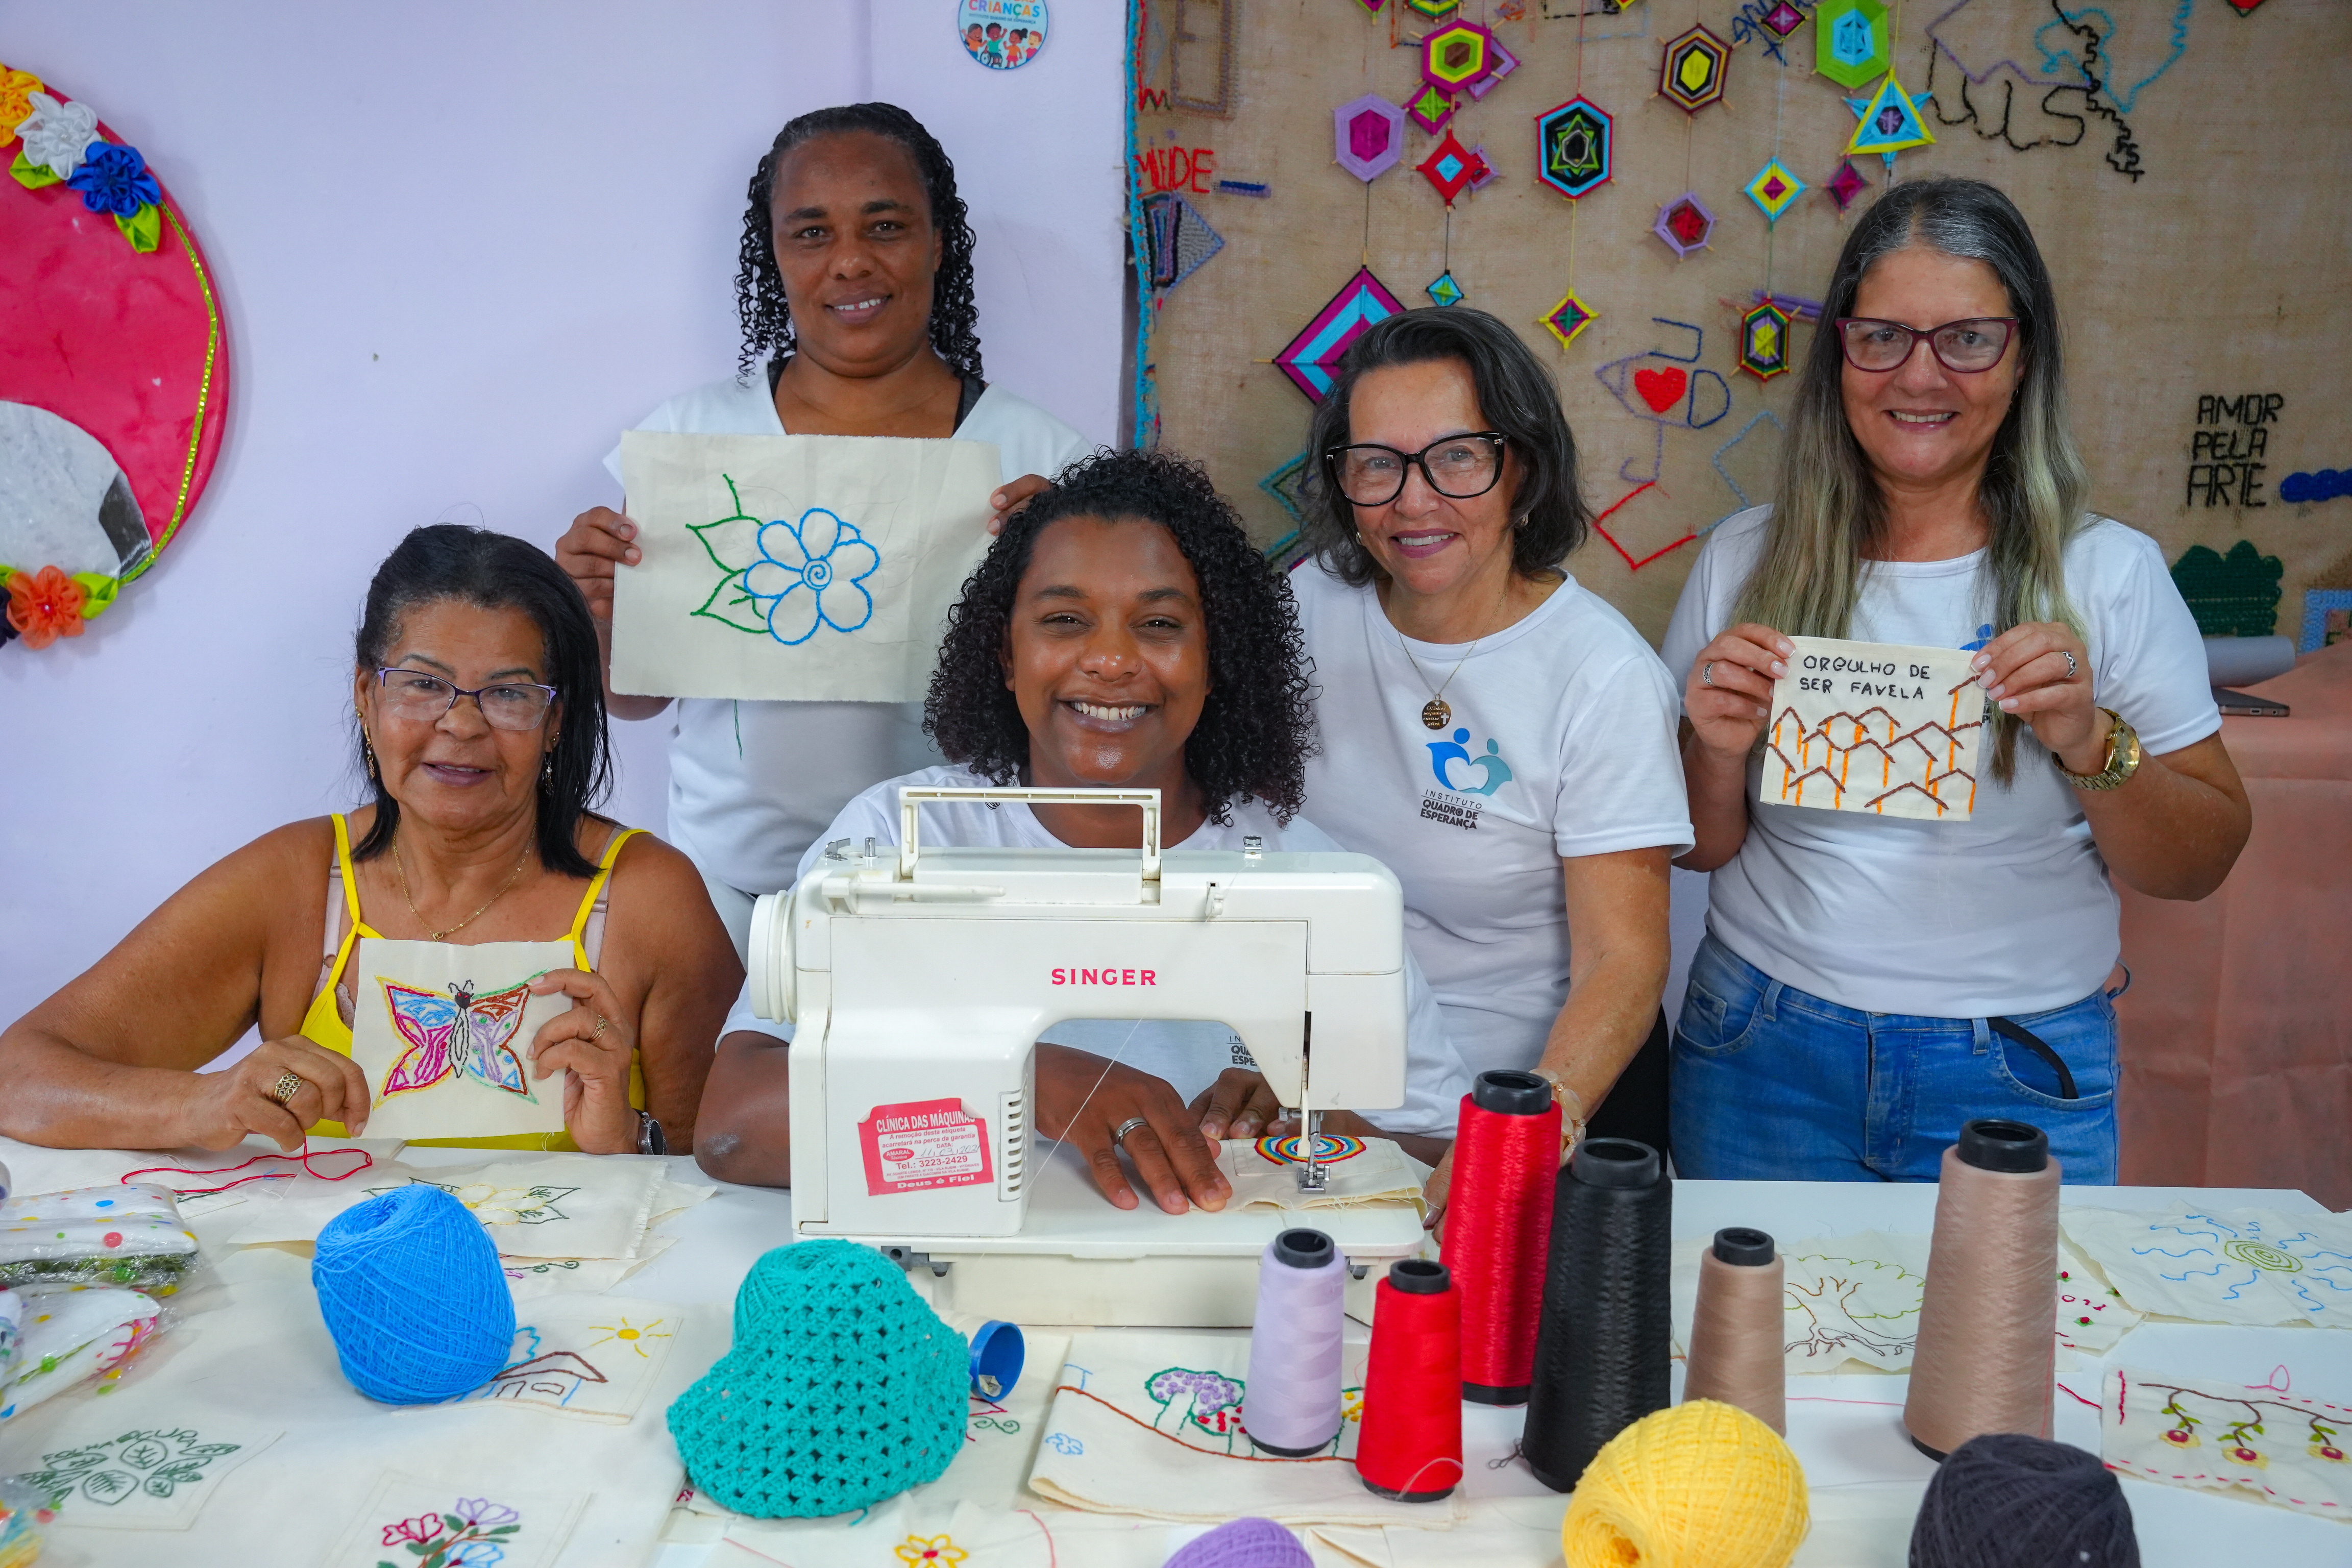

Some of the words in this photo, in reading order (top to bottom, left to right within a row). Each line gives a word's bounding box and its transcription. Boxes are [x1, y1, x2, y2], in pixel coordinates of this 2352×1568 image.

[969, 0, 1040, 19] CRIANÇAS
[2197, 394, 2284, 425] AMOR
[2193, 428, 2267, 460] PELA
[2187, 463, 2267, 507] ARTE
[1804, 655, 1895, 675] ORGULHO
[1910, 665, 1930, 679] DE
[1800, 677, 1832, 693] SER
[1851, 682, 1923, 699] FAVELA
[1426, 789, 1482, 809] INSTITUTO
[1420, 808, 1477, 830] ESPERANÇA
[1423, 799, 1463, 816] QUADRO
[1465, 810, 1479, 820] DE
[1051, 968, 1157, 985] SINGER
[876, 1114, 911, 1133] CLÍNICA
[911, 1115, 929, 1129] DAS
[883, 1139, 913, 1148] acarretará
[951, 1133, 975, 1141] garantia
[896, 1162, 916, 1170] Tel.:
[919, 1156, 968, 1167] 3223-2429
[897, 1180, 932, 1188] Deus
[949, 1174, 974, 1183] Fiel
